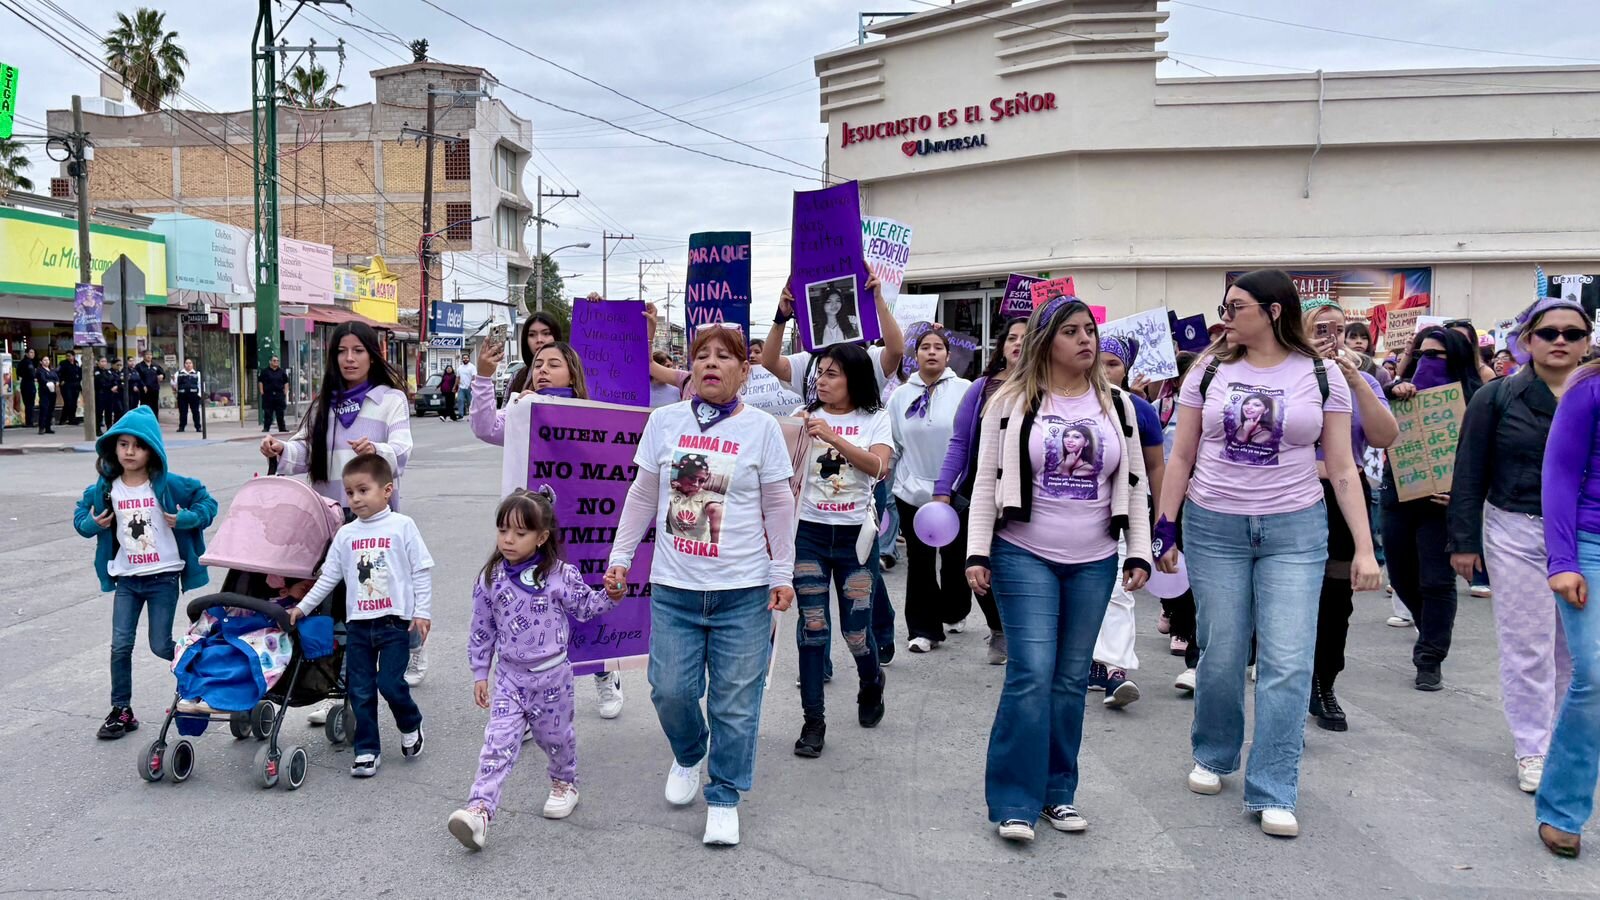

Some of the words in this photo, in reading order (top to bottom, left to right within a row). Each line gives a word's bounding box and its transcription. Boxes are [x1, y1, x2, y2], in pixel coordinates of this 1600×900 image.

[2, 66, 13, 112] SIGA
[841, 114, 931, 148] JESUCRISTO
[937, 108, 958, 128] ES
[965, 105, 983, 124] EL
[990, 91, 1058, 122] SEÑOR
[916, 133, 988, 156] UNIVERSAL
[215, 228, 232, 240] Globos
[862, 219, 911, 245] MUERTE
[42, 247, 57, 267] La
[59, 246, 113, 272] Micacana
[867, 238, 910, 265] PEDOFILO
[688, 280, 748, 303] NIÑA...
[1292, 278, 1330, 293] SANTO
[447, 308, 463, 328] telcel
[687, 306, 724, 325] VIVA
[538, 425, 609, 443] QUIEN
[611, 431, 643, 445] AM
[845, 425, 860, 436] DE
[1399, 421, 1413, 433] or
[678, 434, 720, 452] MAMÁ
[721, 440, 740, 455] DE
[533, 461, 573, 480] NO
[118, 498, 141, 510] NIETA
[143, 497, 155, 508] DE
[576, 497, 616, 515] NO
[816, 502, 856, 512] YESIKA
[352, 537, 376, 551] NIETO
[378, 537, 391, 549] DE
[673, 535, 719, 558] YESIKA
[127, 552, 160, 565] YESIKA
[578, 558, 608, 575] NI
[357, 597, 393, 611] YESIKA
[591, 623, 642, 648] López
